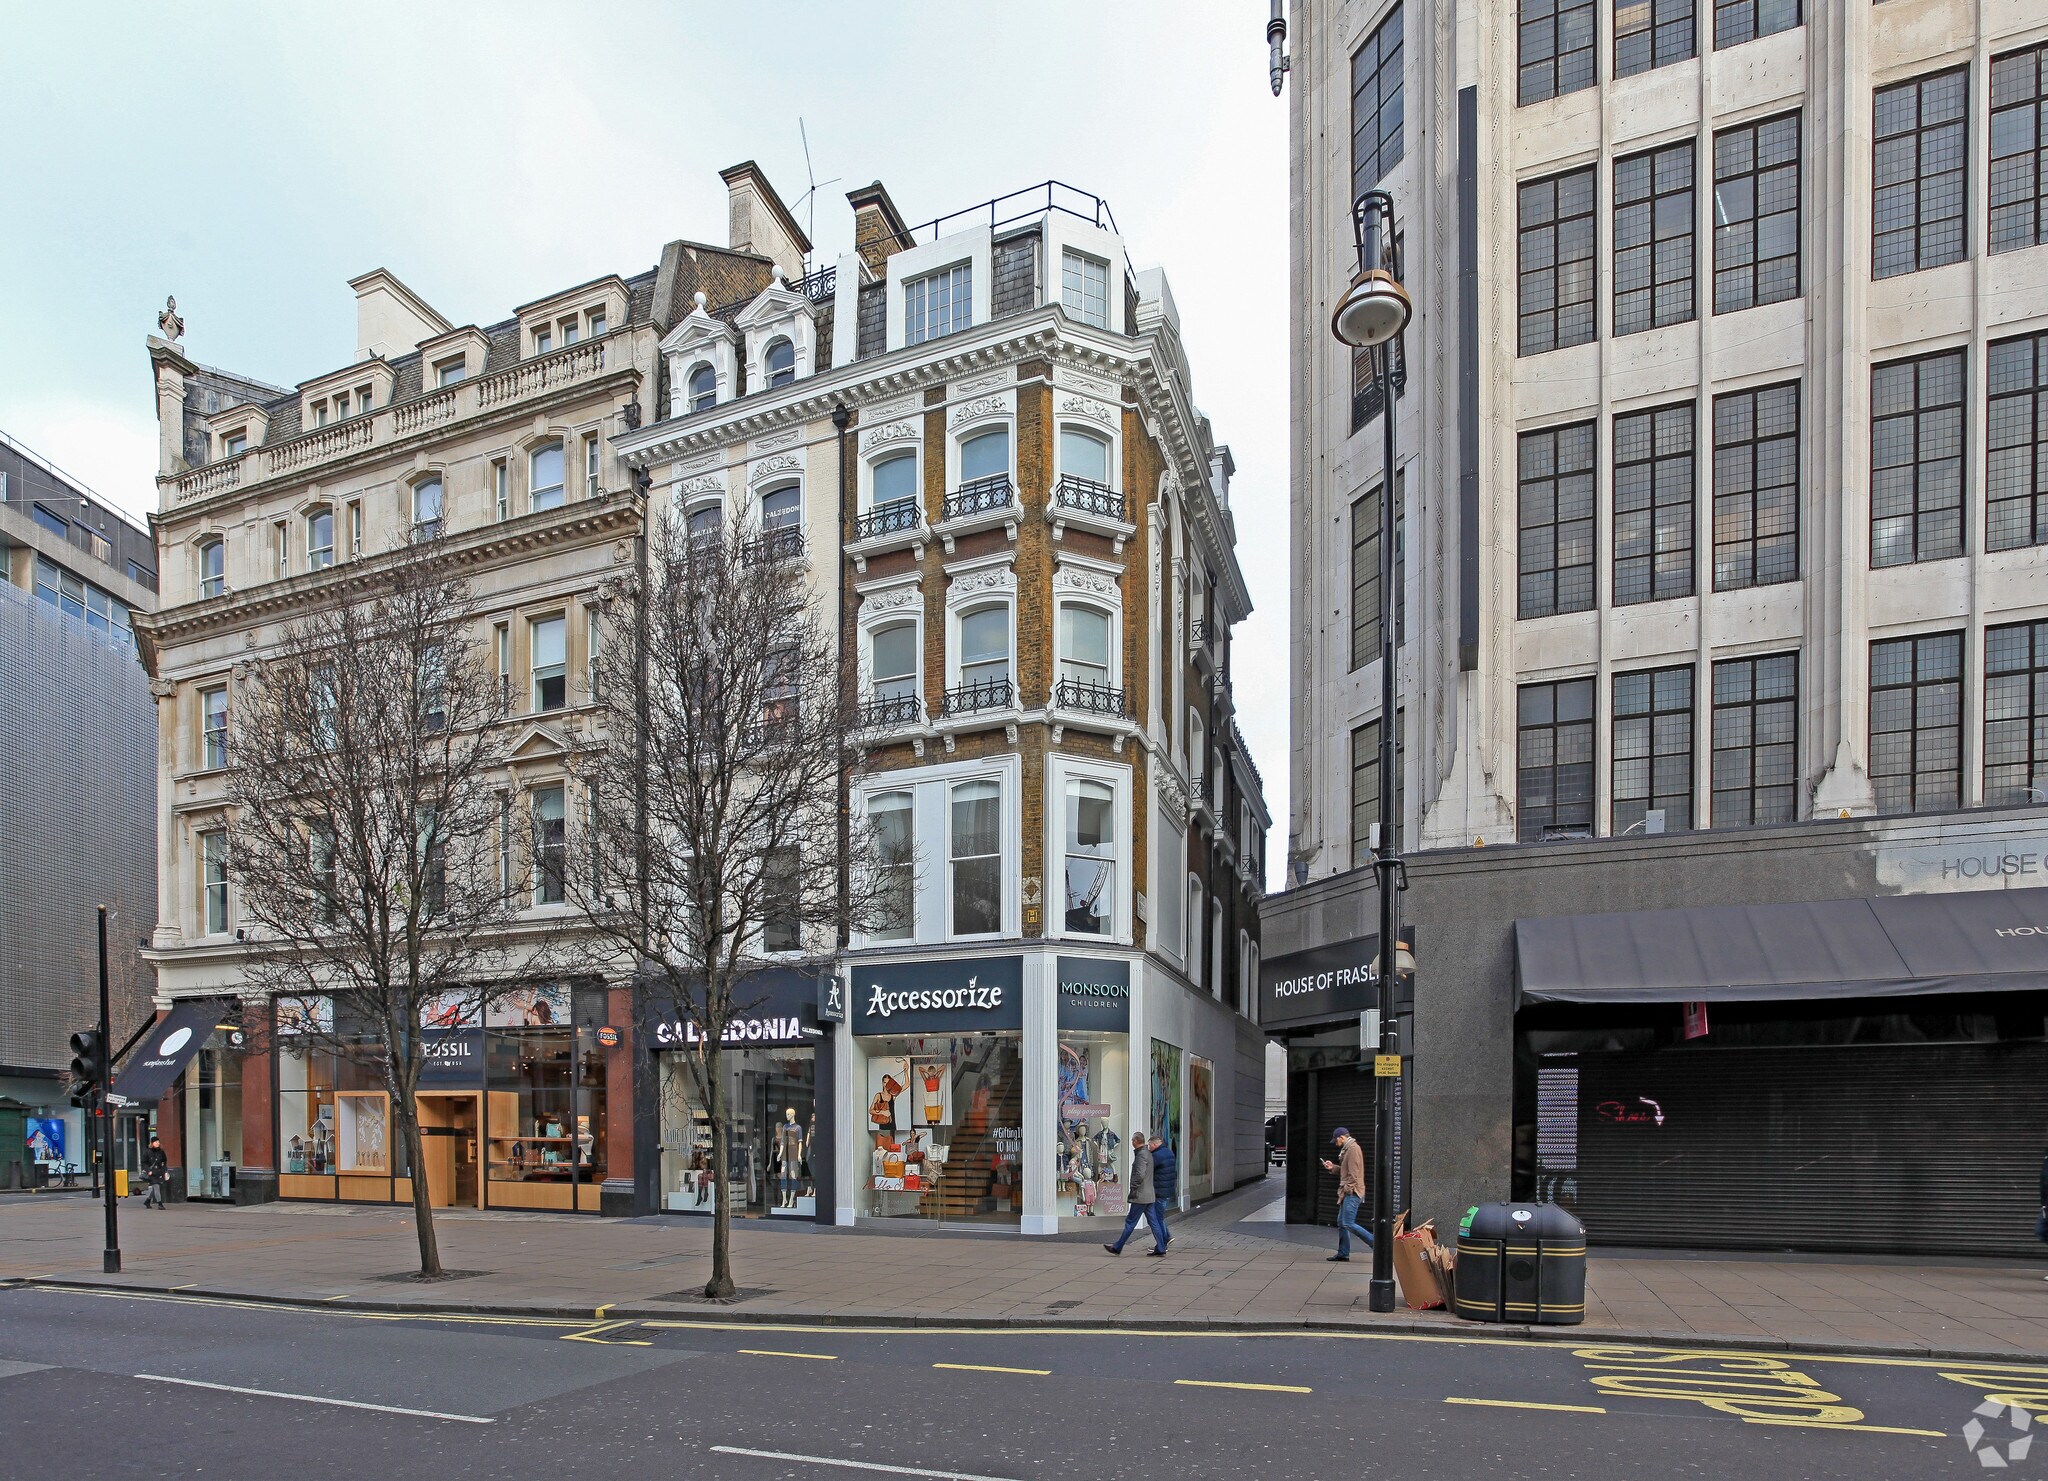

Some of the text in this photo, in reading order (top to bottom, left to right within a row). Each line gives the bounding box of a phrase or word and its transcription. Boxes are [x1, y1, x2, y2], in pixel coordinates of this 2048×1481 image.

[1941, 852, 2039, 880] HOUSE
[1061, 981, 1129, 997] MONSOON
[1275, 975, 1315, 998] HOUSE
[1316, 971, 1334, 990] OF
[866, 976, 1002, 1018] Accessorize
[1070, 999, 1119, 1008] CHILDREN
[599, 1032, 618, 1041] FOSSIL
